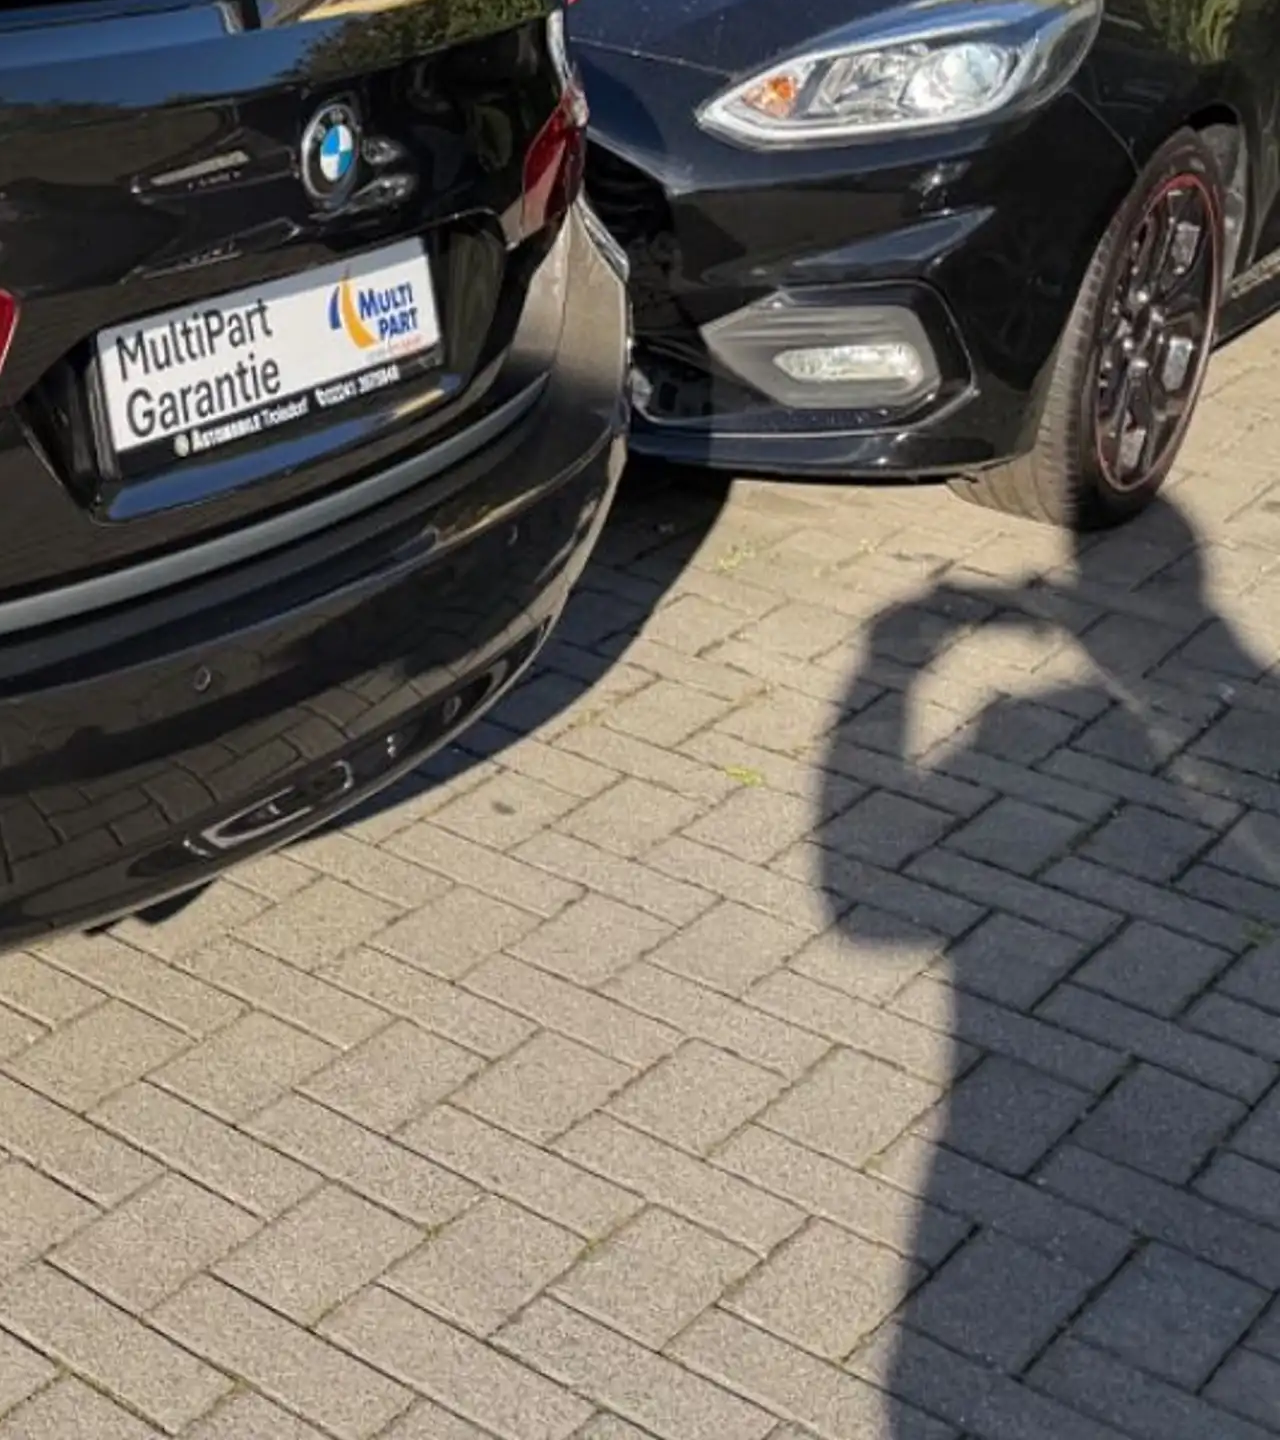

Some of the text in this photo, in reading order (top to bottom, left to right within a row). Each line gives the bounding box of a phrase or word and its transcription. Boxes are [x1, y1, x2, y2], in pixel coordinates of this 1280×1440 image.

[358, 281, 414, 321] MULTI
[378, 306, 418, 340] PART
[115, 298, 273, 382] MultiPart
[126, 352, 281, 438] Garantie
